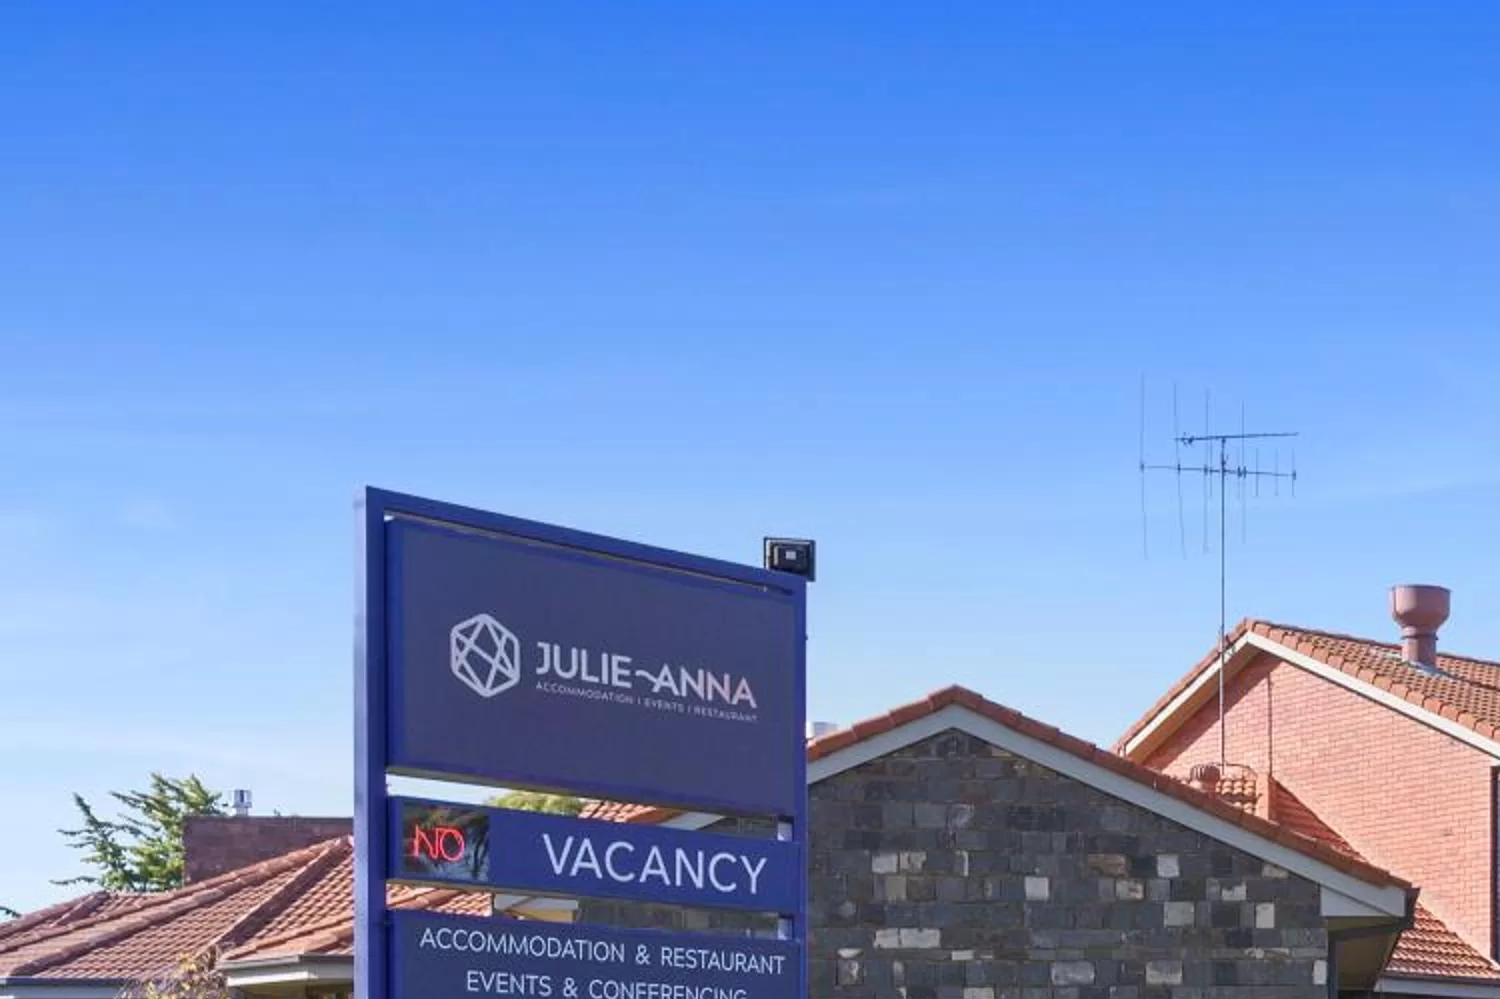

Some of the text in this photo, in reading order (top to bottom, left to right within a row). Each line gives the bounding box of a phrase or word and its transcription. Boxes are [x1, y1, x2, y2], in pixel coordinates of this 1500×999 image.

[644, 699, 684, 713] EVENTS
[693, 707, 758, 722] RESTAURANT
[412, 824, 768, 895] NO VACANCY
[419, 927, 785, 975] ACCOMMODATION & RESTAURANT
[467, 970, 552, 997] EVENTS
[562, 978, 578, 998] &
